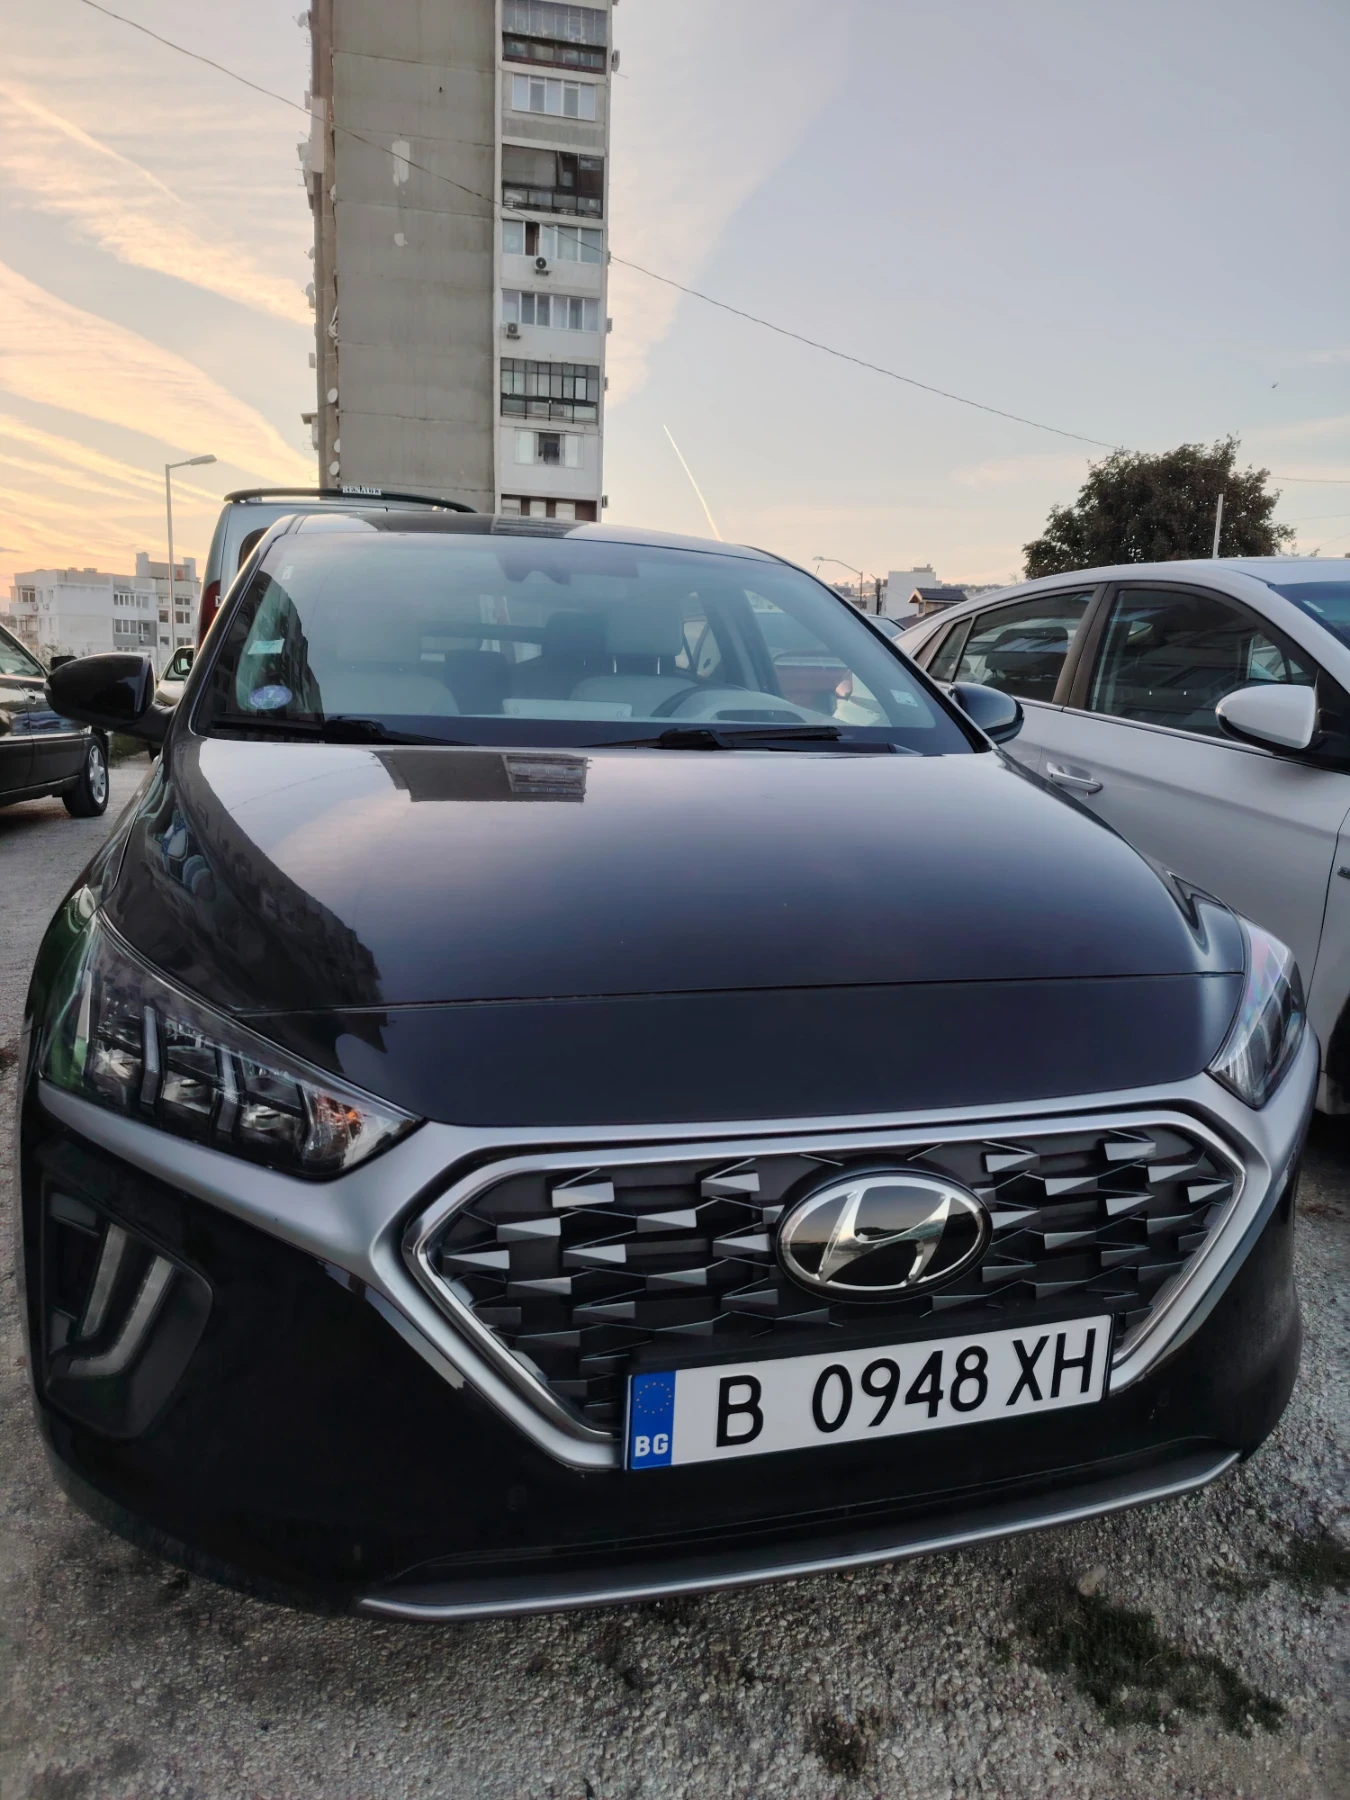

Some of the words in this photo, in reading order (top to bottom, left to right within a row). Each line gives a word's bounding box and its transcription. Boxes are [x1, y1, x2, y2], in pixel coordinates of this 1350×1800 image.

[342, 485, 382, 496] RENAULT
[715, 1374, 764, 1448] B
[811, 1345, 989, 1434] 0948
[1005, 1327, 1097, 1407] XH
[634, 1433, 669, 1457] BG
